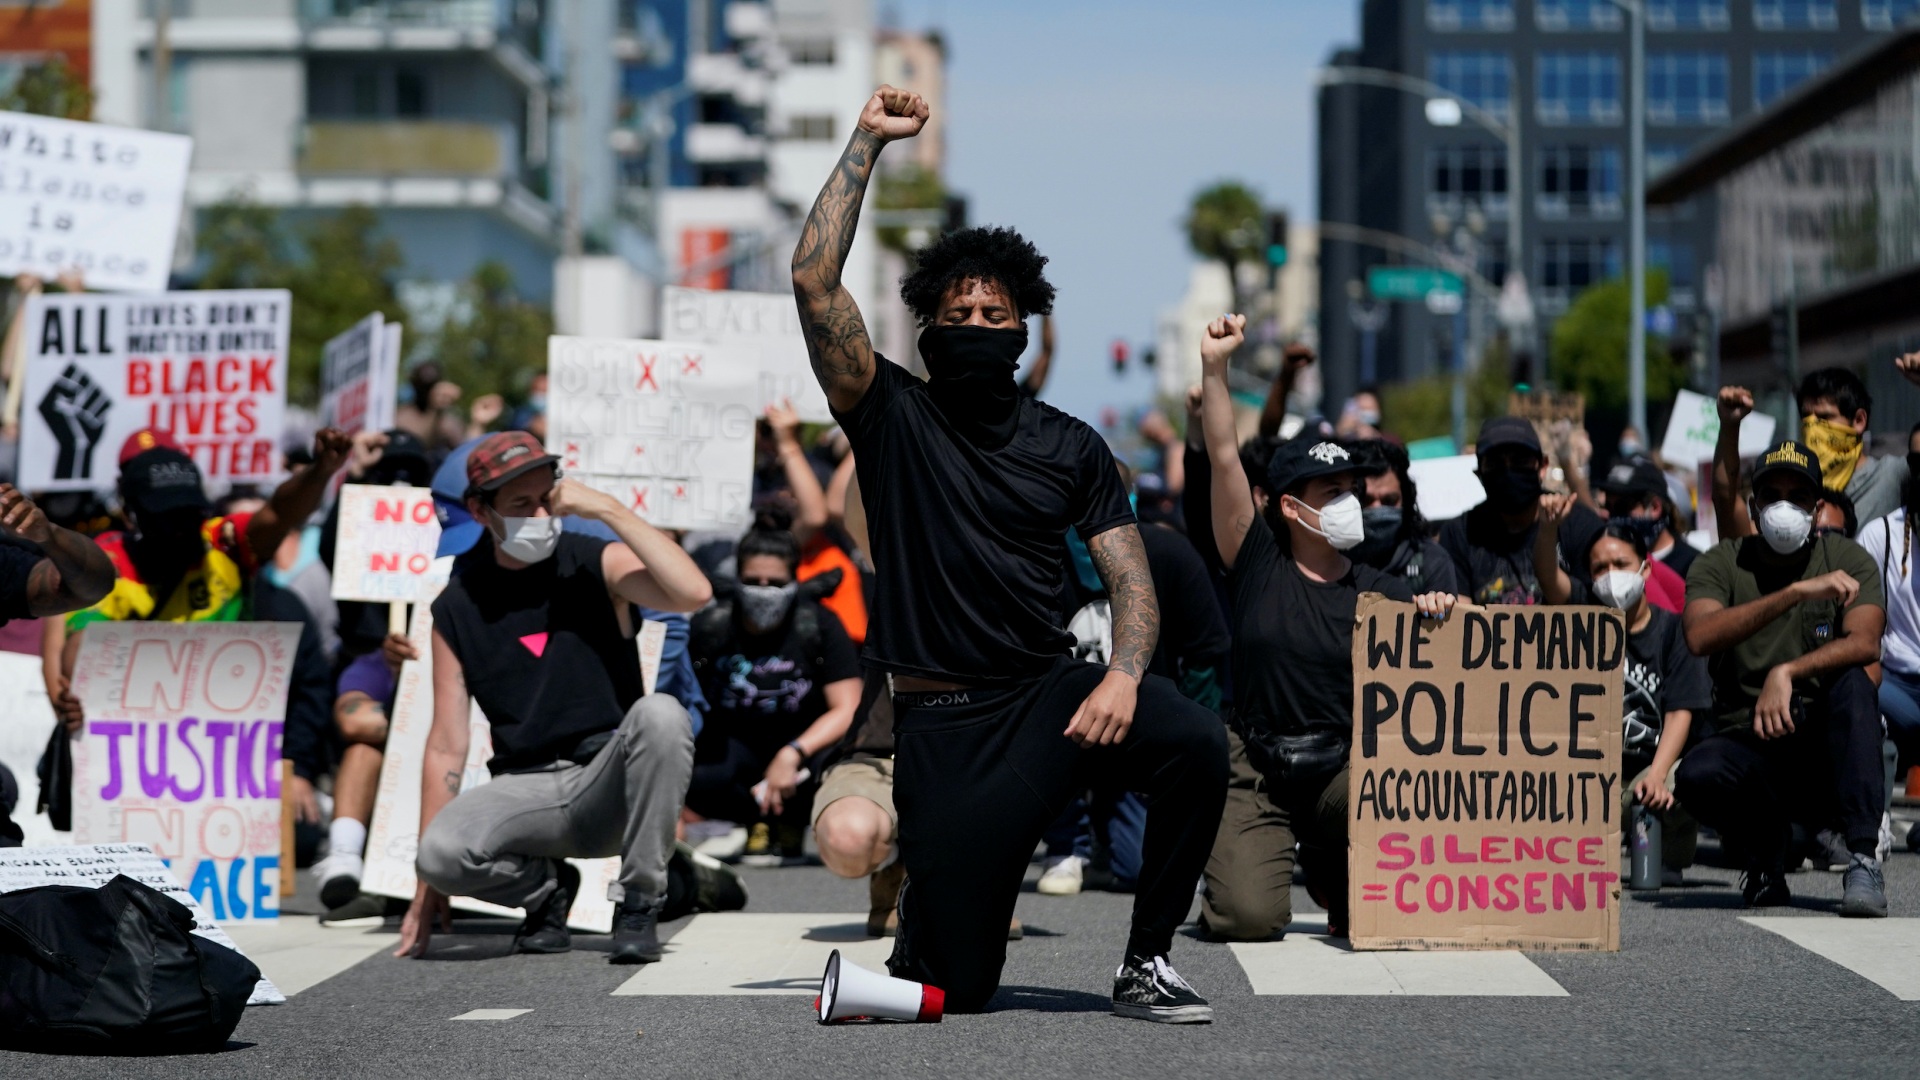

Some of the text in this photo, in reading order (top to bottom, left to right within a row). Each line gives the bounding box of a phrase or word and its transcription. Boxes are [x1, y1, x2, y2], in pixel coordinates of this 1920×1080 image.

[40, 307, 112, 354] ALL
[126, 302, 197, 326] LIVES
[127, 330, 277, 352] MATTER UNTIL
[126, 356, 277, 397] BLACK
[149, 398, 258, 437] LIVES
[181, 440, 273, 478] TTER
[374, 499, 436, 525] NO
[369, 552, 429, 575] NO
[1367, 611, 1625, 672] WE DEMAND
[120, 637, 267, 714] NO
[1361, 681, 1607, 760] POLICE
[1357, 768, 1618, 825] ACCOUNTABILITY
[120, 805, 248, 862] NO
[1376, 832, 1606, 870] SILENCE
[66, 857, 116, 867] BROWN
